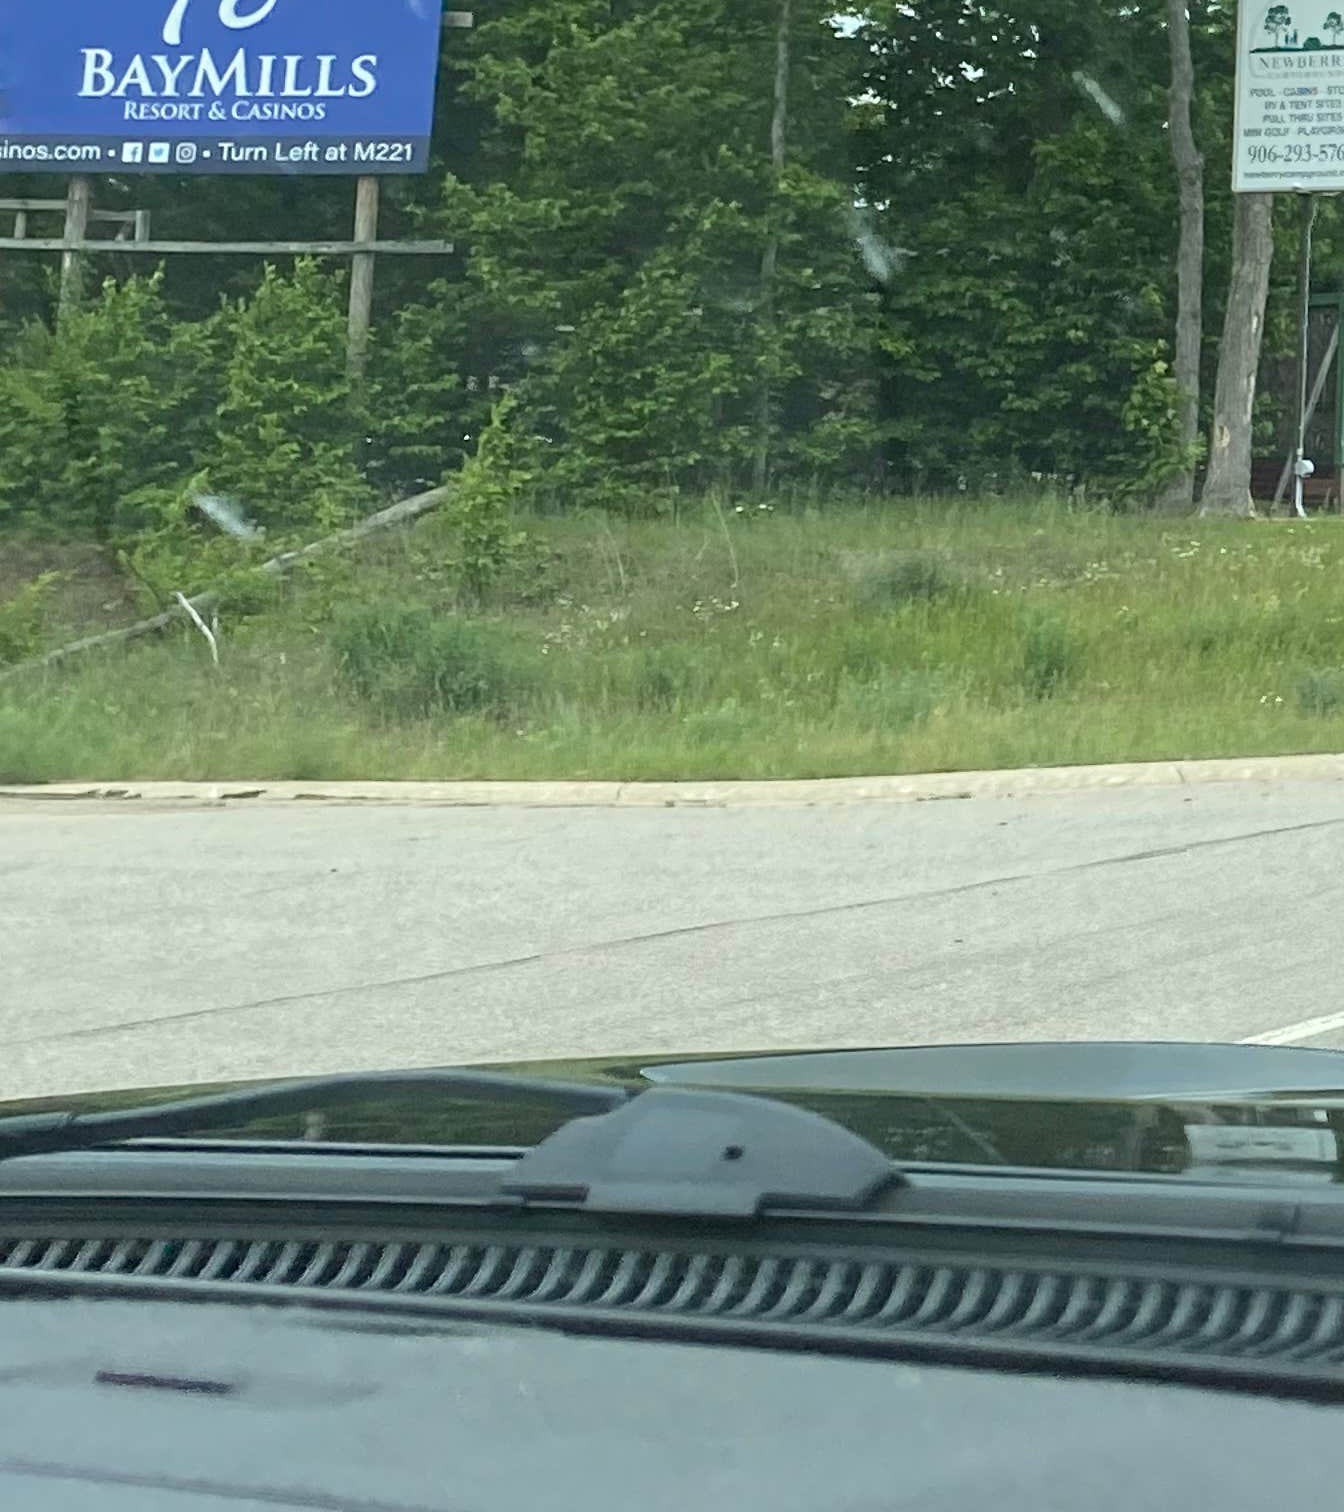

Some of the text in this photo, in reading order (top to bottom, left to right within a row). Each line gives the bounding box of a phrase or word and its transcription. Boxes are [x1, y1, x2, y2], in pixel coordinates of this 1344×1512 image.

[124, 101, 326, 121] RESORT & CASINOS
[1290, 100, 1313, 109] TENT
[1315, 99, 1342, 108] SITES
[1262, 112, 1342, 123] PULL THRU SITES
[218, 142, 267, 161] Turn
[275, 142, 319, 161] Left
[325, 144, 347, 161] at
[354, 143, 413, 161] M221
